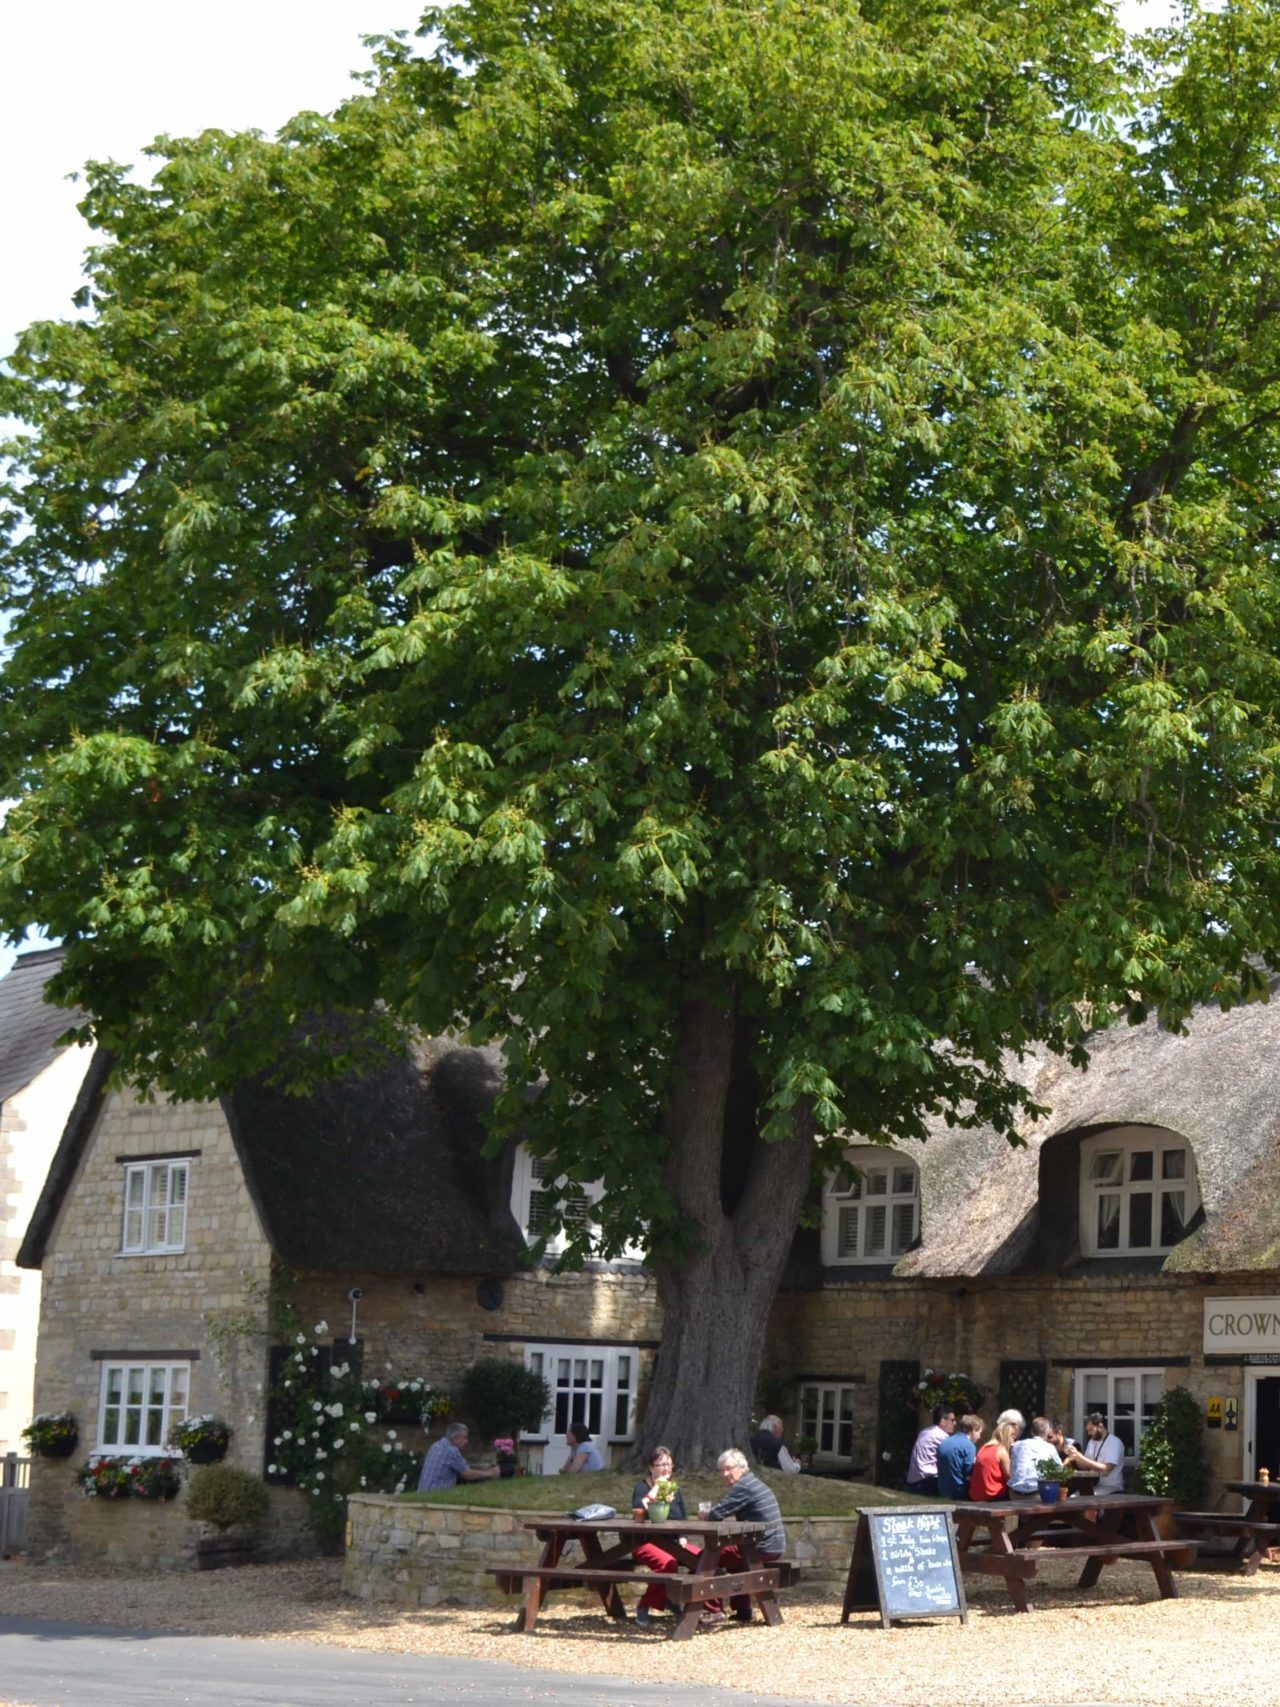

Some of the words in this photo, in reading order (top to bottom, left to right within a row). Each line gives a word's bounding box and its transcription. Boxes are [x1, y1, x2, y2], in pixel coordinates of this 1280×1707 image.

[882, 1516, 914, 1532] Steak
[917, 1514, 941, 1531] Night
[880, 1534, 897, 1547] 1st
[899, 1534, 915, 1549] July
[882, 1549, 888, 1560] 2
